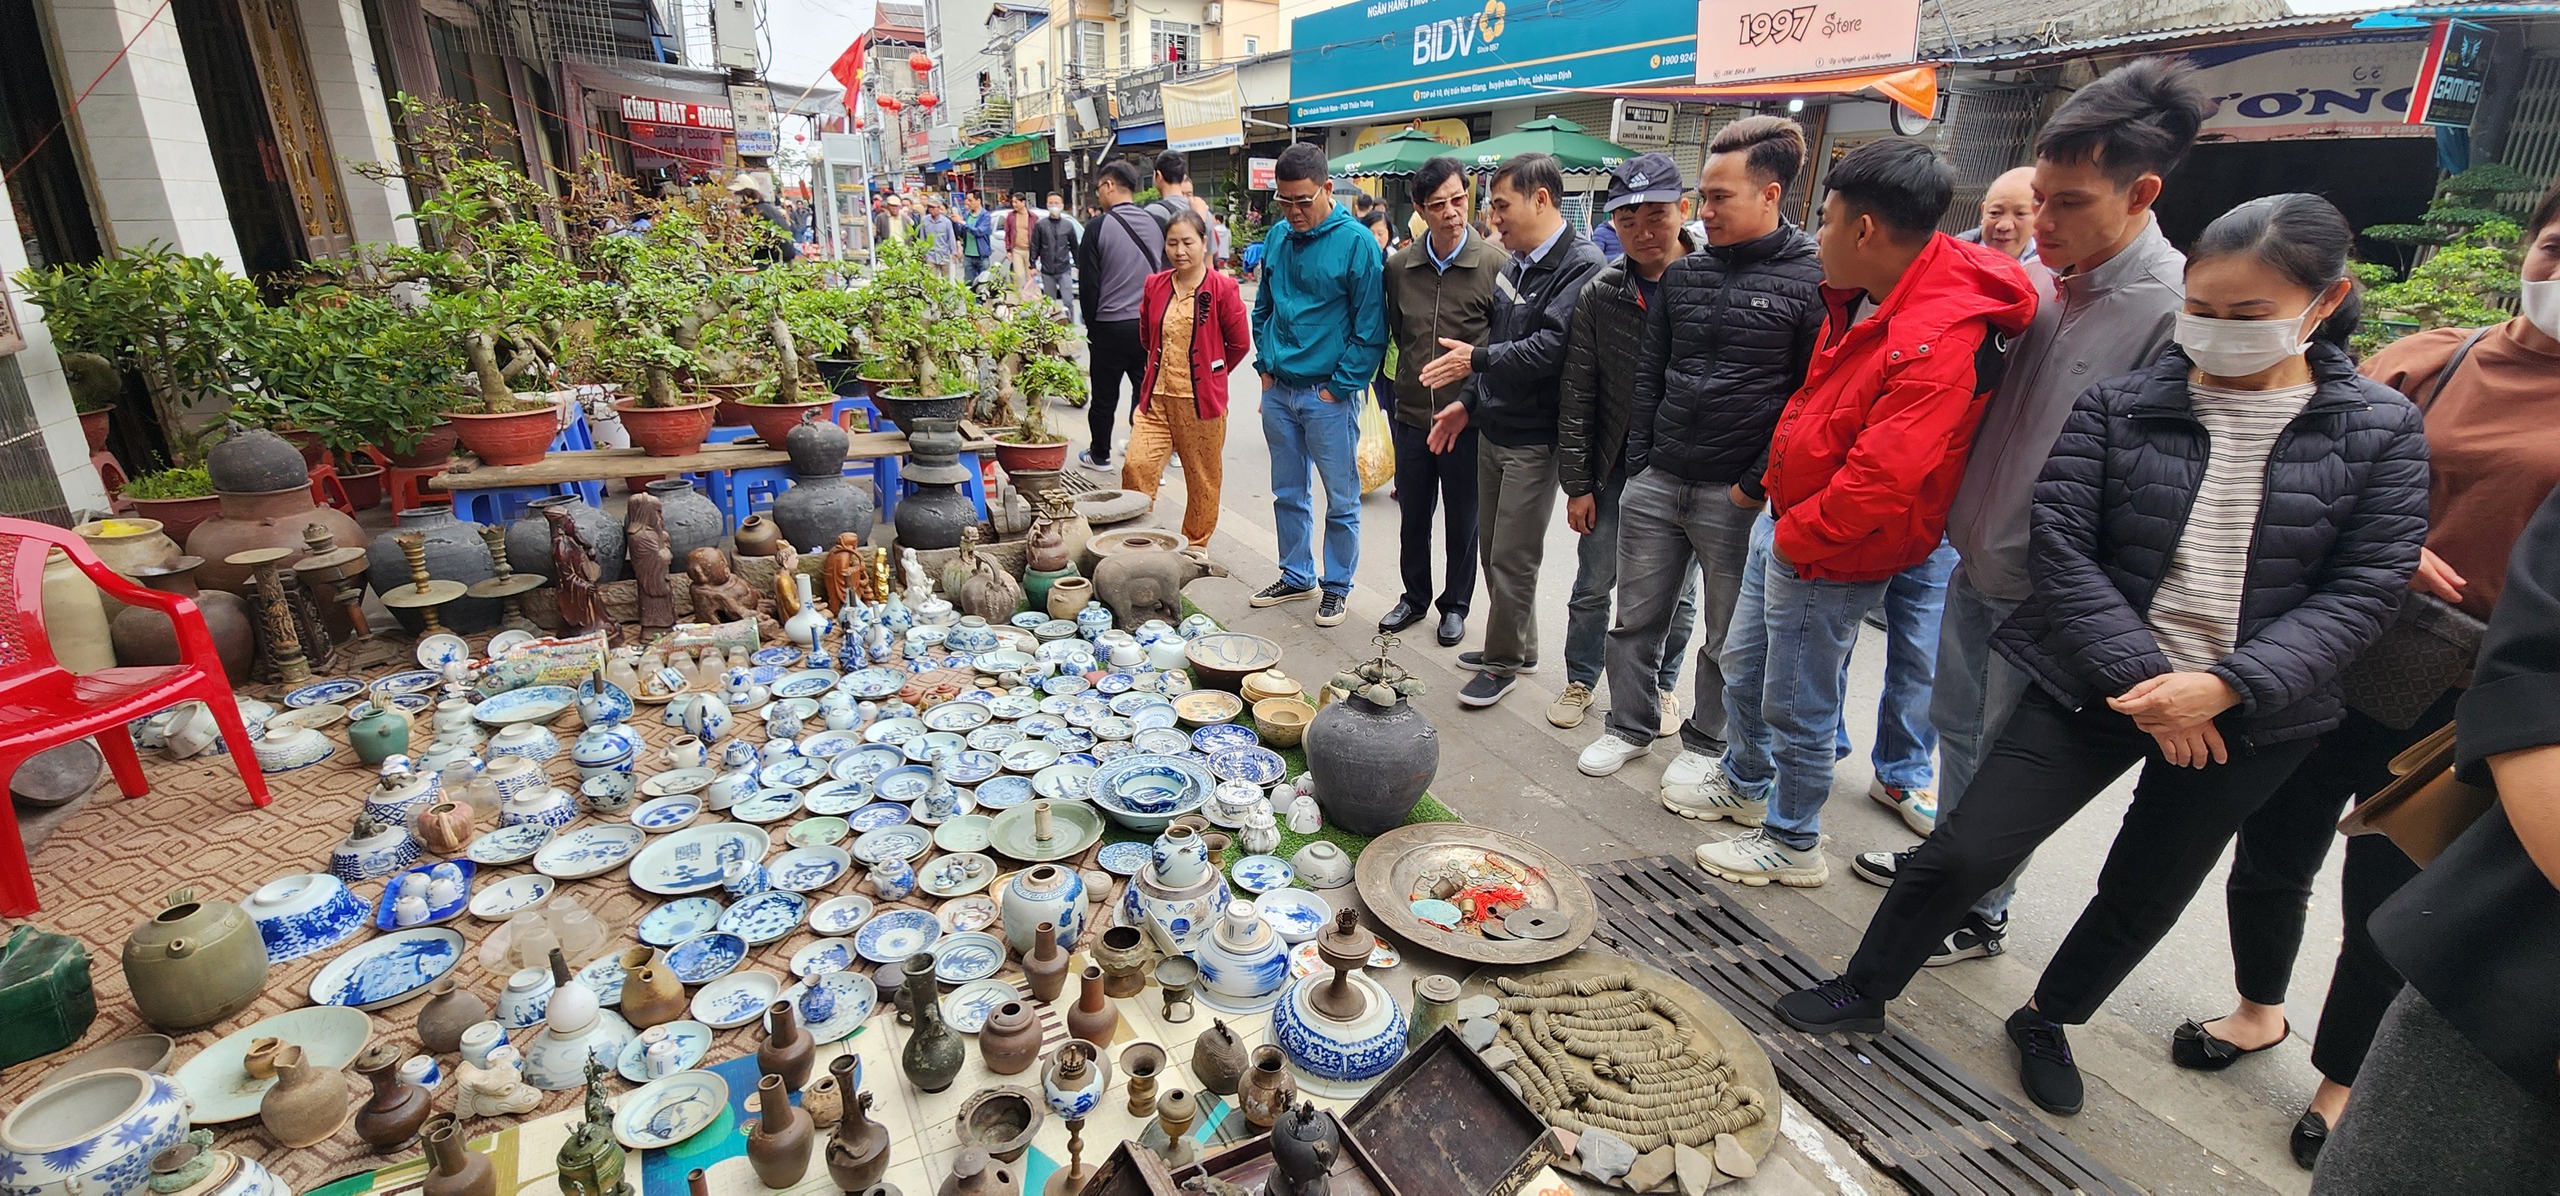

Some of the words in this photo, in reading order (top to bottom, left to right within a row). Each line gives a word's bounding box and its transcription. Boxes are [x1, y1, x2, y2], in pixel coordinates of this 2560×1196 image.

[1367, 2, 1387, 18] NGÂN
[1412, 12, 1481, 66] BIDV
[1739, 5, 1817, 47] 1997
[1822, 11, 1862, 38] Store
[1662, 55, 1679, 66] 1900
[1460, 85, 1471, 94] Nam
[1505, 78, 1517, 87] Nam
[1544, 73, 1557, 82] Nam
[1558, 70, 1572, 81] Định
[2434, 75, 2481, 103] GAMING
[622, 95, 656, 121] KÍNH
[1777, 385, 1814, 443] VOGUE
